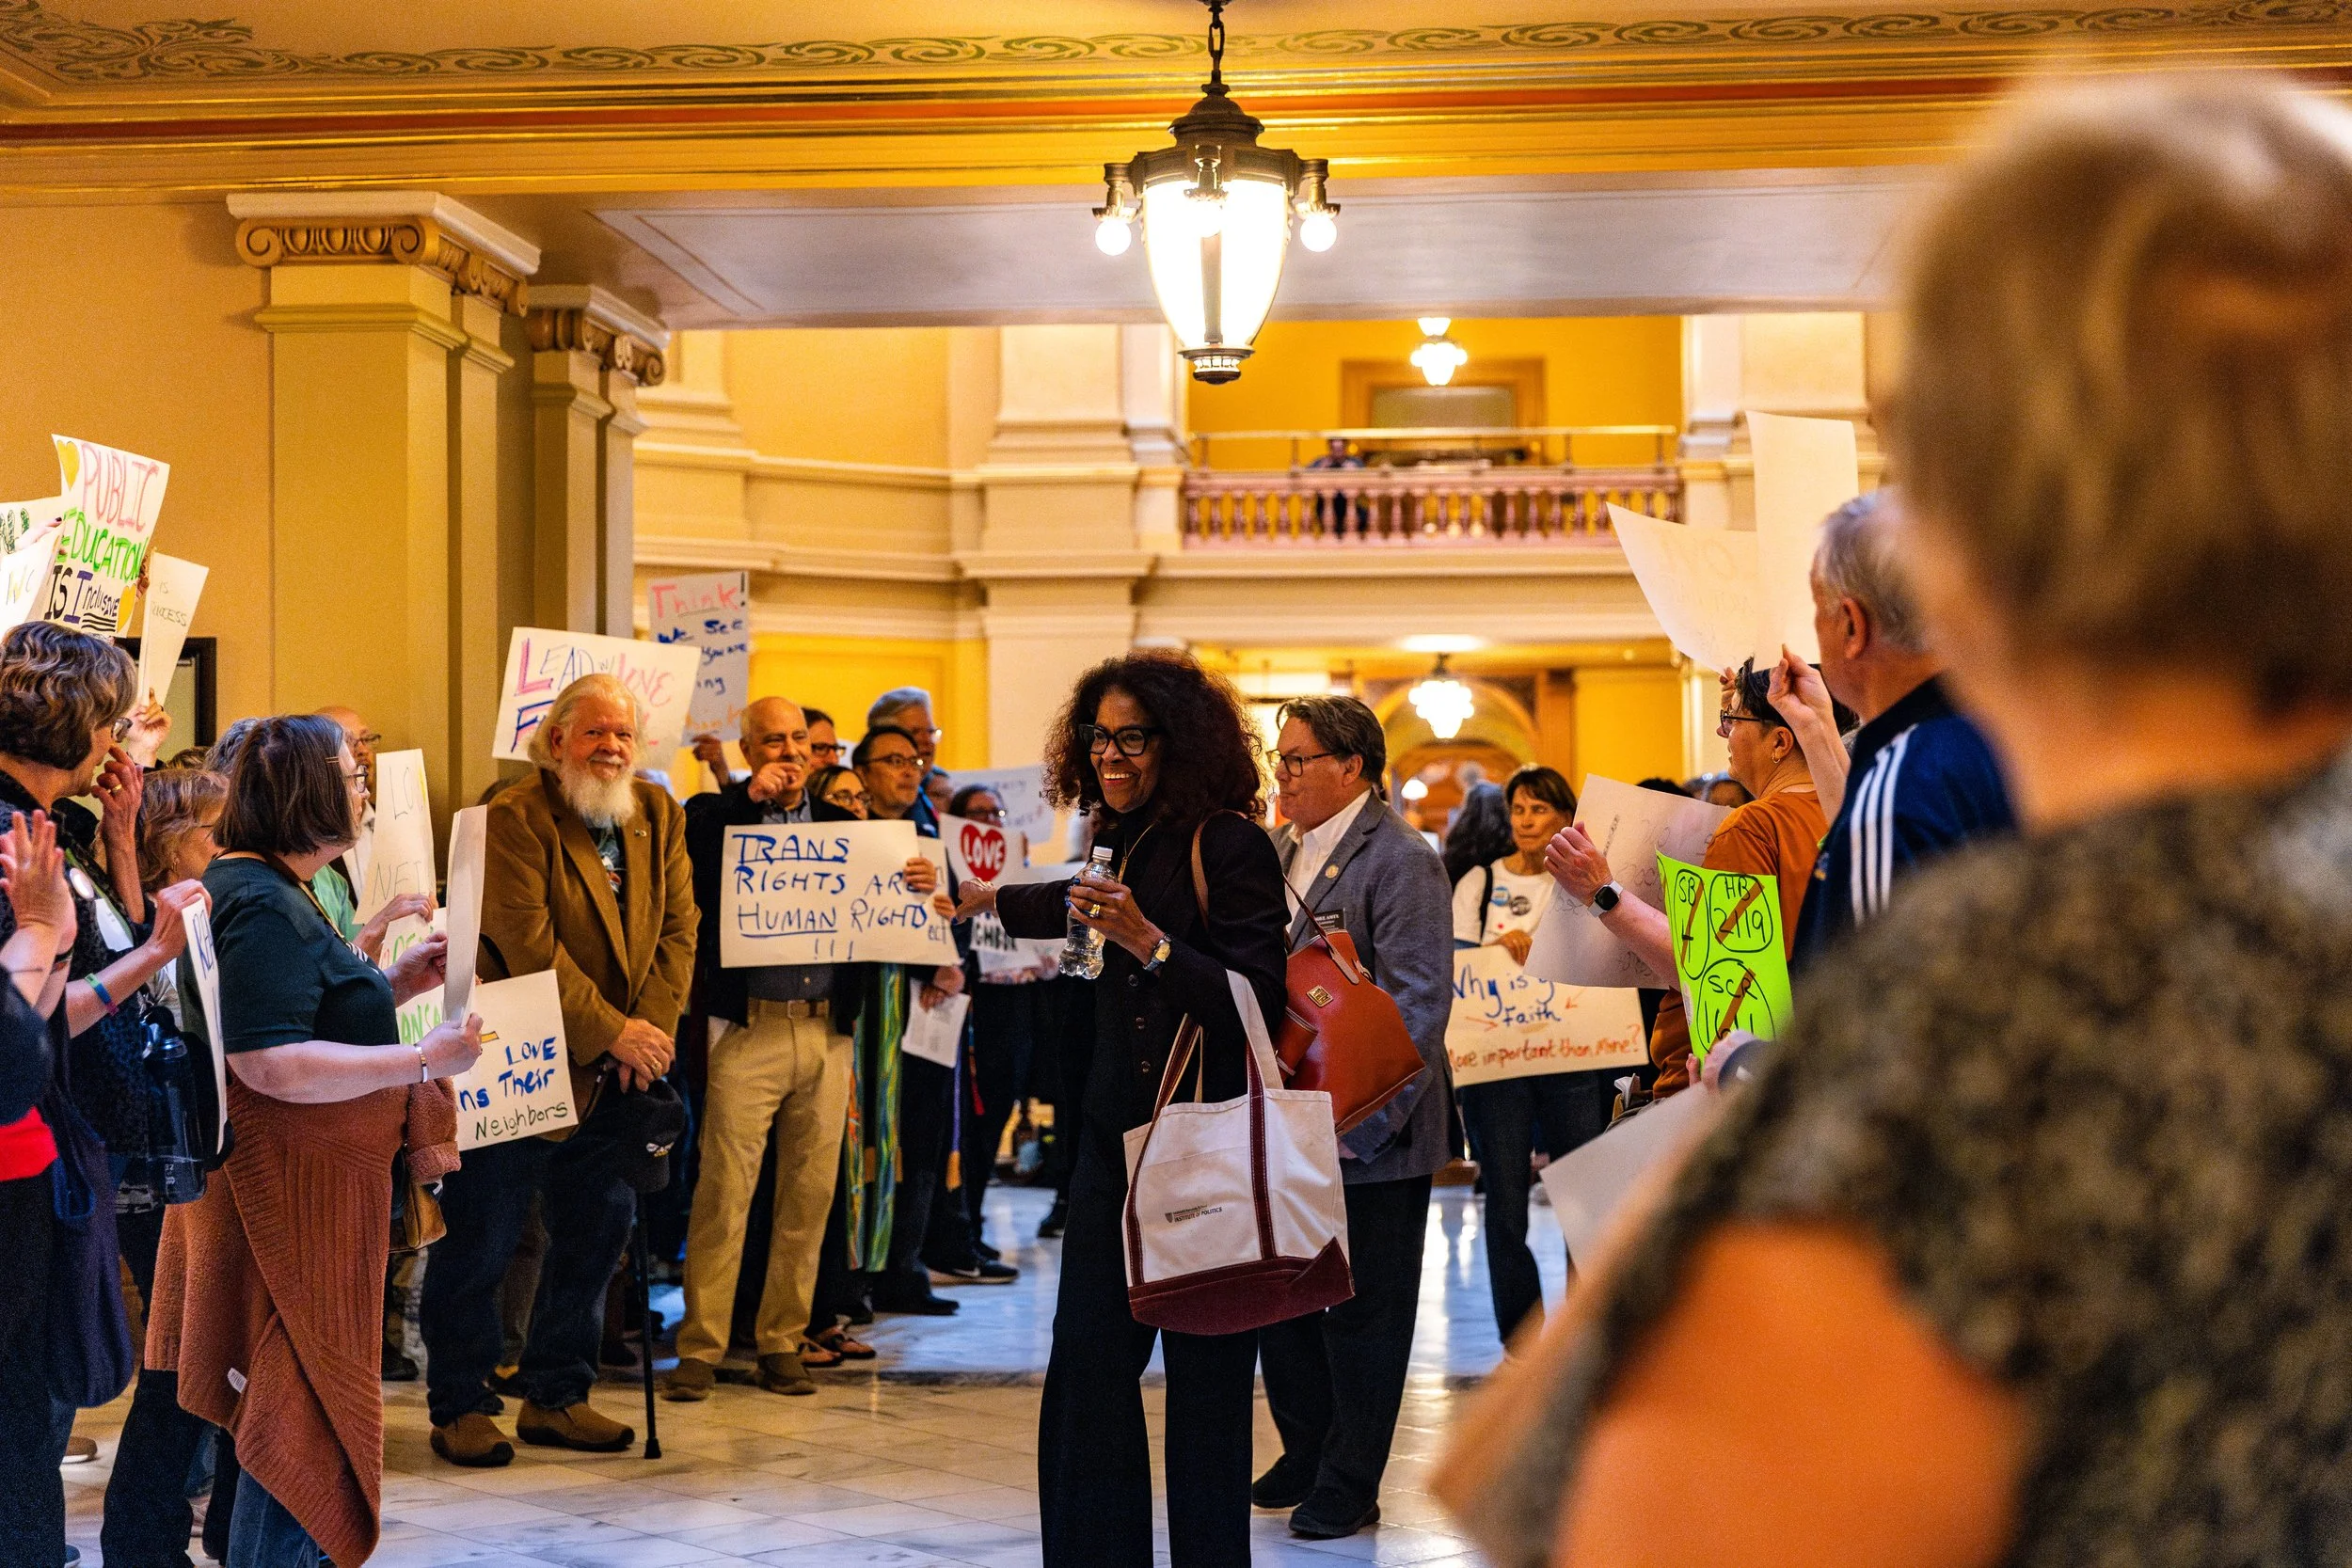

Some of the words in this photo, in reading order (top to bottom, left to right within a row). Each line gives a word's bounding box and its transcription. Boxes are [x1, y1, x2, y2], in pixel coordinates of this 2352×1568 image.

[80, 441, 160, 533] PUBLIC
[44, 564, 73, 621] IS
[732, 834, 850, 864] TRANS
[962, 834, 1004, 871] LOVE
[734, 865, 846, 894] RIGHTS
[1678, 876, 1696, 907] SB
[1724, 877, 1751, 901] HB
[738, 902, 837, 931] HUMAN
[1708, 974, 1757, 1000] SCR
[505, 1037, 557, 1066] LOVE
[1483, 1038, 1555, 1068] important
[498, 1069, 555, 1099] Their
[475, 1101, 567, 1140] Neighbors
